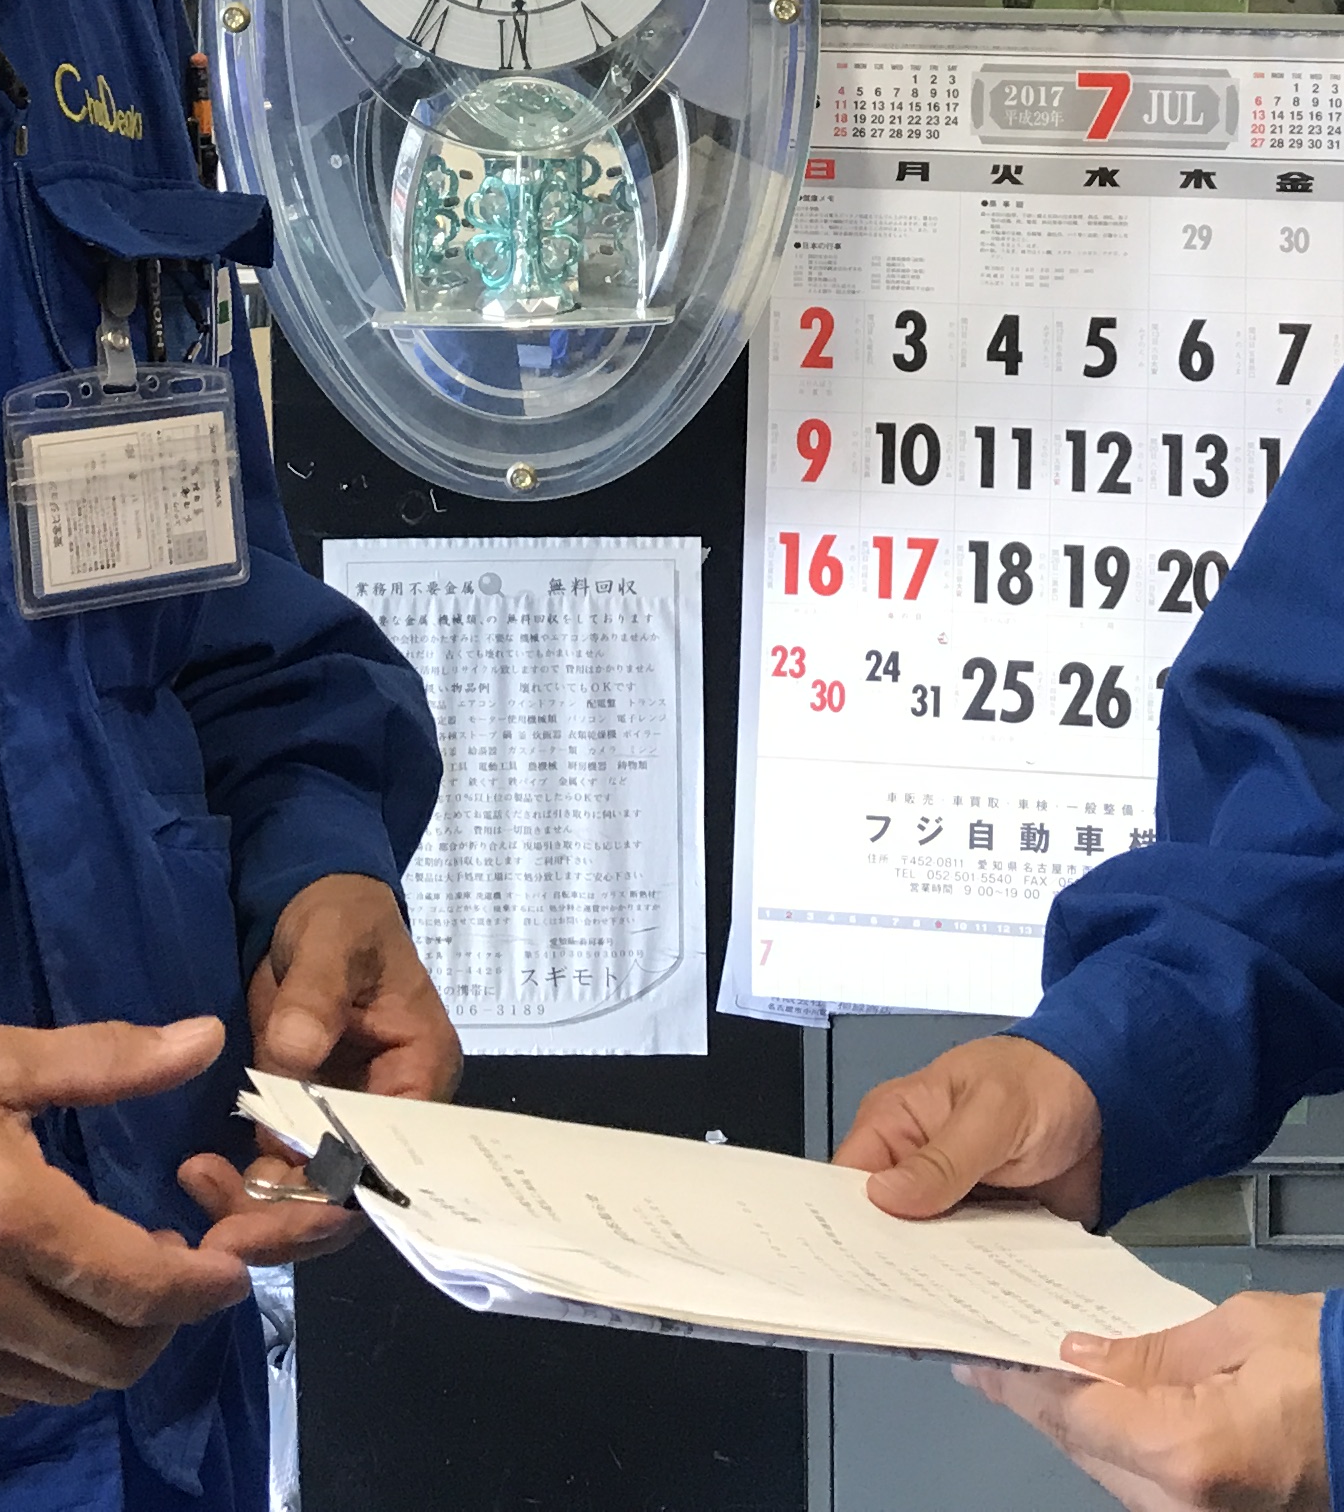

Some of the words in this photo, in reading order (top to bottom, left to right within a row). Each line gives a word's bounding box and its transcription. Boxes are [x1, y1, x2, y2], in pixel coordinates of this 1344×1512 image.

[834, 100, 847, 110] 11
[853, 100, 867, 111] 12
[872, 101, 885, 111] 13
[890, 101, 904, 111] 14
[908, 102, 922, 112] 15
[927, 102, 940, 112] 16
[945, 103, 959, 113] 17
[1004, 84, 1064, 107] 2017
[1075, 70, 1132, 143] 7
[1143, 89, 1204, 126] JUL
[1004, 109, 1065, 127] 平成29年
[805, 158, 835, 180] 日
[896, 161, 930, 182] 月
[991, 164, 1024, 185] 火
[1084, 167, 1120, 187] 水
[1179, 169, 1218, 189] 木
[1276, 172, 1314, 193] 金
[1182, 224, 1213, 250] 29
[1279, 227, 1310, 253] 30
[800, 306, 834, 369] 2
[892, 309, 928, 373] 3
[986, 314, 1023, 376] 4
[1083, 316, 1117, 378] 5
[1178, 319, 1214, 382] 6
[1275, 323, 1312, 385] 7
[796, 418, 832, 482] 9
[875, 422, 941, 486] 10
[974, 426, 1032, 490] 11
[1065, 429, 1132, 494] 12
[1162, 433, 1229, 498] 13
[1260, 437, 1281, 502] 1
[356, 579, 475, 597] 業務用不要金属
[548, 577, 638, 597] 無料回収
[779, 532, 844, 597] 16
[873, 535, 940, 601] 17
[968, 540, 1034, 606] 18
[1063, 544, 1131, 610] 19
[1157, 548, 1230, 613] 20
[770, 644, 806, 679] 23
[865, 649, 901, 683] 24
[810, 679, 846, 713] 30
[910, 683, 941, 718] 31
[961, 656, 1035, 724] 25
[1058, 661, 1132, 729] 26
[895, 868, 916, 880] TEL
[1023, 875, 1048, 887] FAX
[759, 939, 773, 966] 7
[520, 967, 620, 988] スギモト
